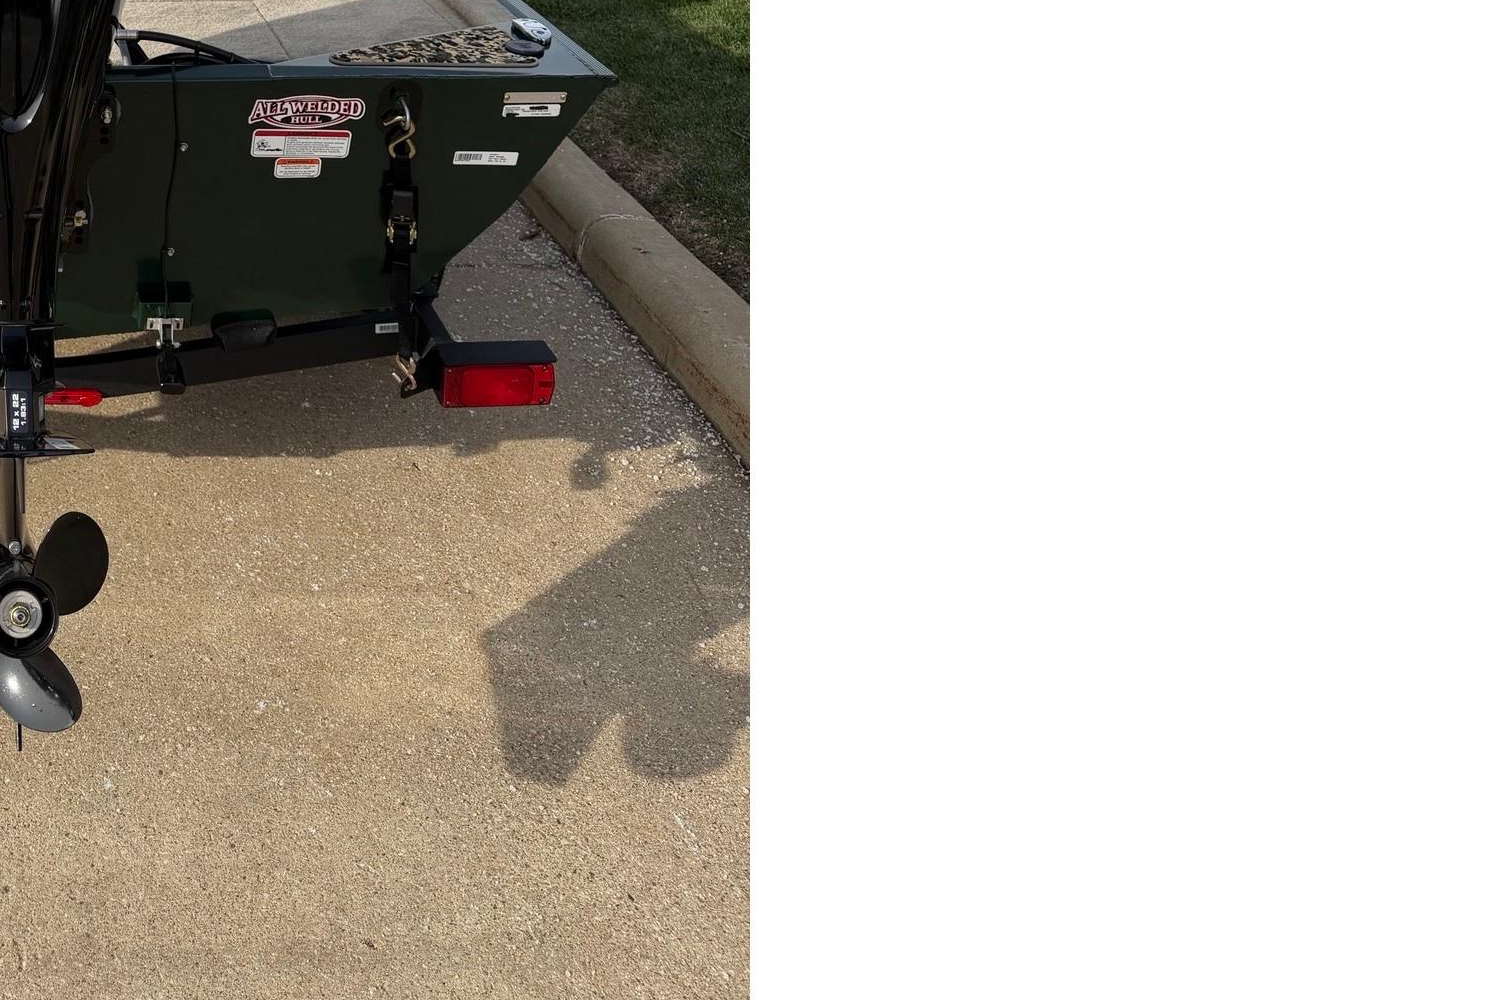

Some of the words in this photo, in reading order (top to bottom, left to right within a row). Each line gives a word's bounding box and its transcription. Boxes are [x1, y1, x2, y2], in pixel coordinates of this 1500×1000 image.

[252, 100, 287, 121] ALL
[289, 99, 363, 117] WELDED
[290, 115, 323, 124] HULL
[12, 393, 20, 408] 22
[12, 418, 20, 431] 12
